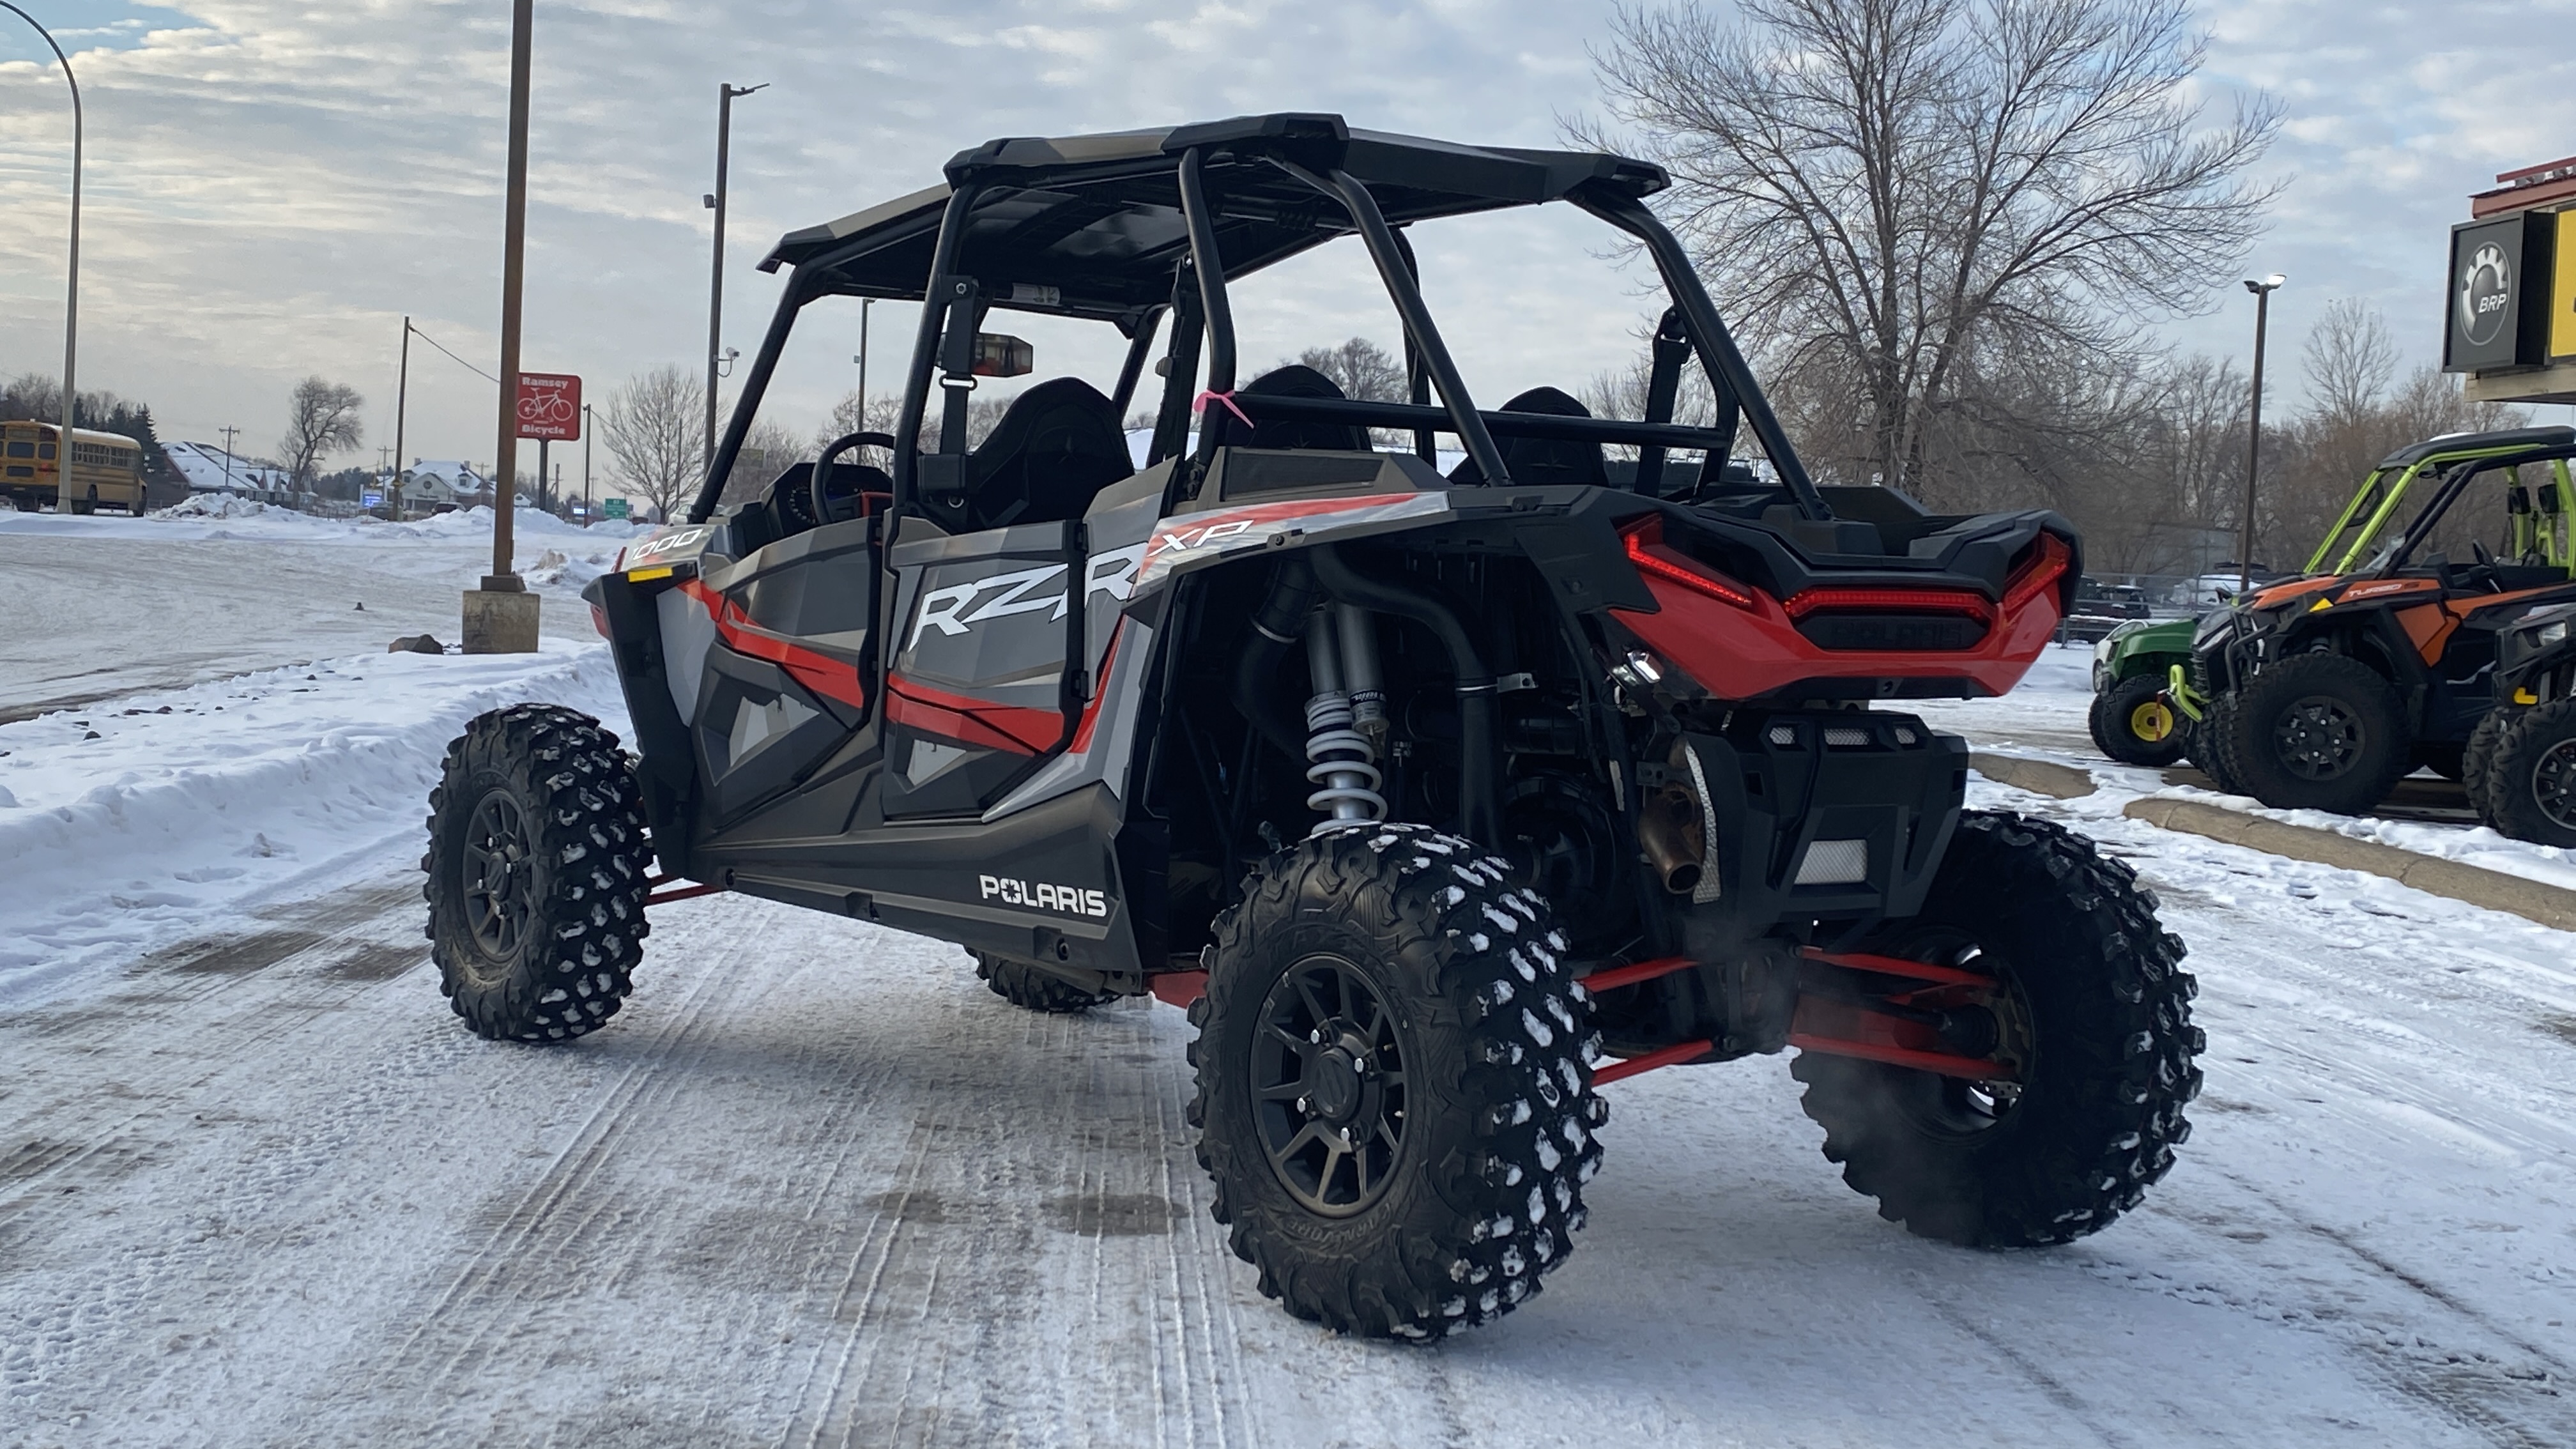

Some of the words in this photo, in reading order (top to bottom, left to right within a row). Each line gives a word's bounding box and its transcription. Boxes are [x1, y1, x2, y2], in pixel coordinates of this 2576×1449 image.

[2478, 293, 2507, 313] BRP
[522, 377, 569, 389] Ramsey
[522, 424, 565, 435] Bicycle
[1146, 519, 1254, 558] XP
[907, 541, 1148, 652] RZR
[2349, 583, 2402, 597] TURBO
[978, 873, 1107, 917] POLARIS
